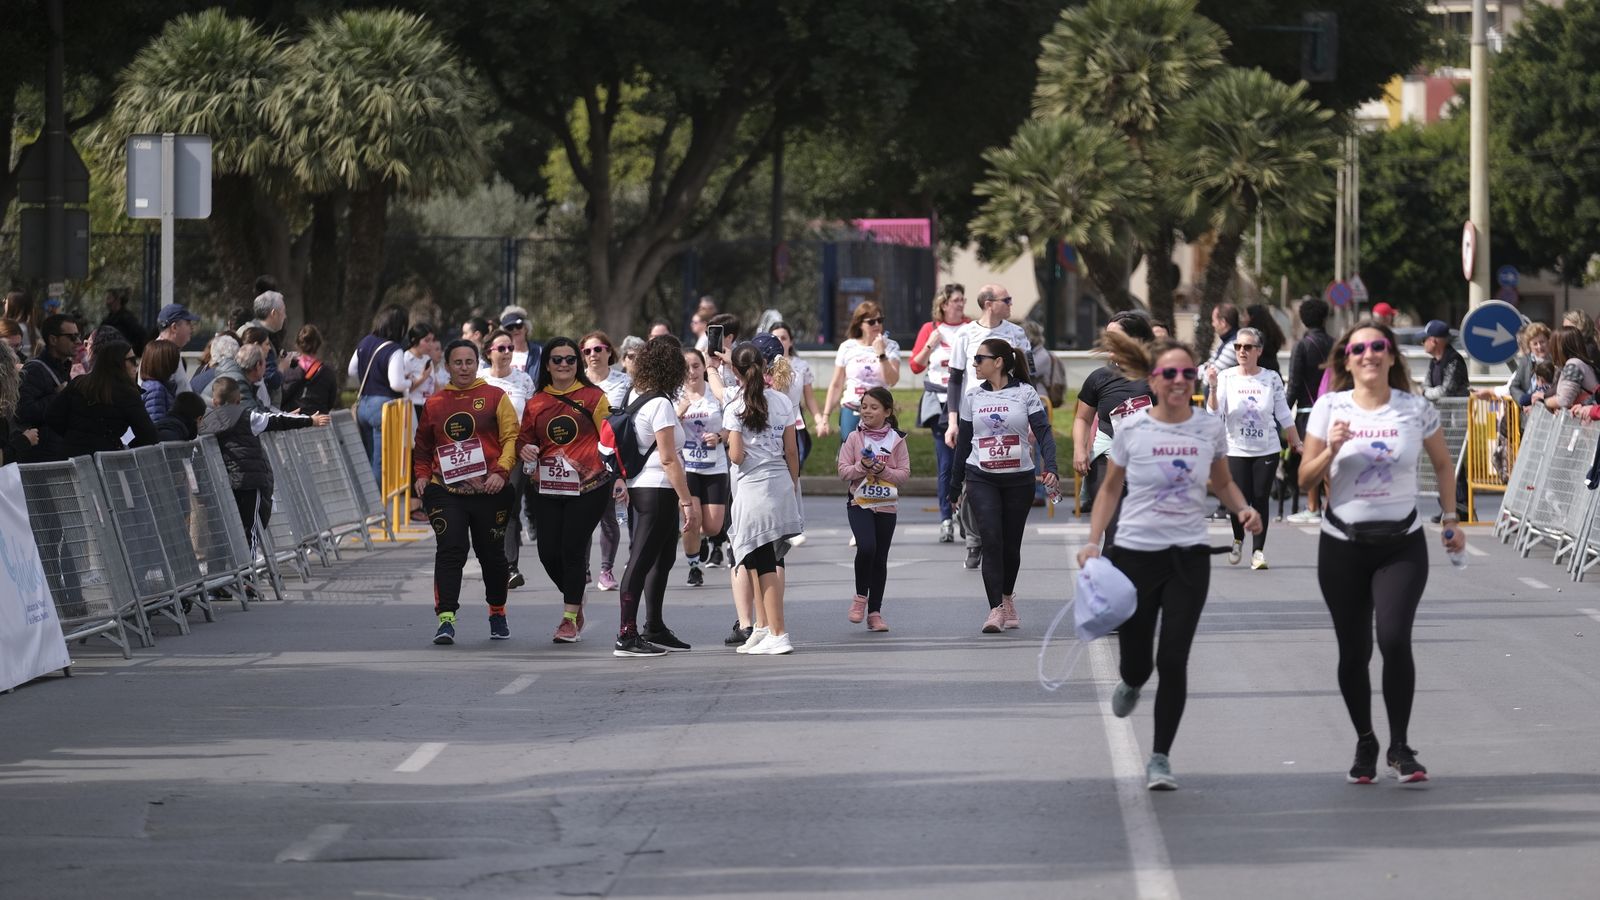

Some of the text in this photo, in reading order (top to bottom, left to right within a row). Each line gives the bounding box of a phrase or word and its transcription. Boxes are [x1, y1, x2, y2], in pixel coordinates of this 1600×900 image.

[1240, 428, 1264, 438] 1326
[1353, 429, 1399, 438] MUJER
[689, 449, 708, 458] 403
[988, 446, 1011, 457] 647
[1152, 447, 1198, 456] MUJER
[450, 451, 472, 465] 527
[861, 485, 891, 497] 1593
